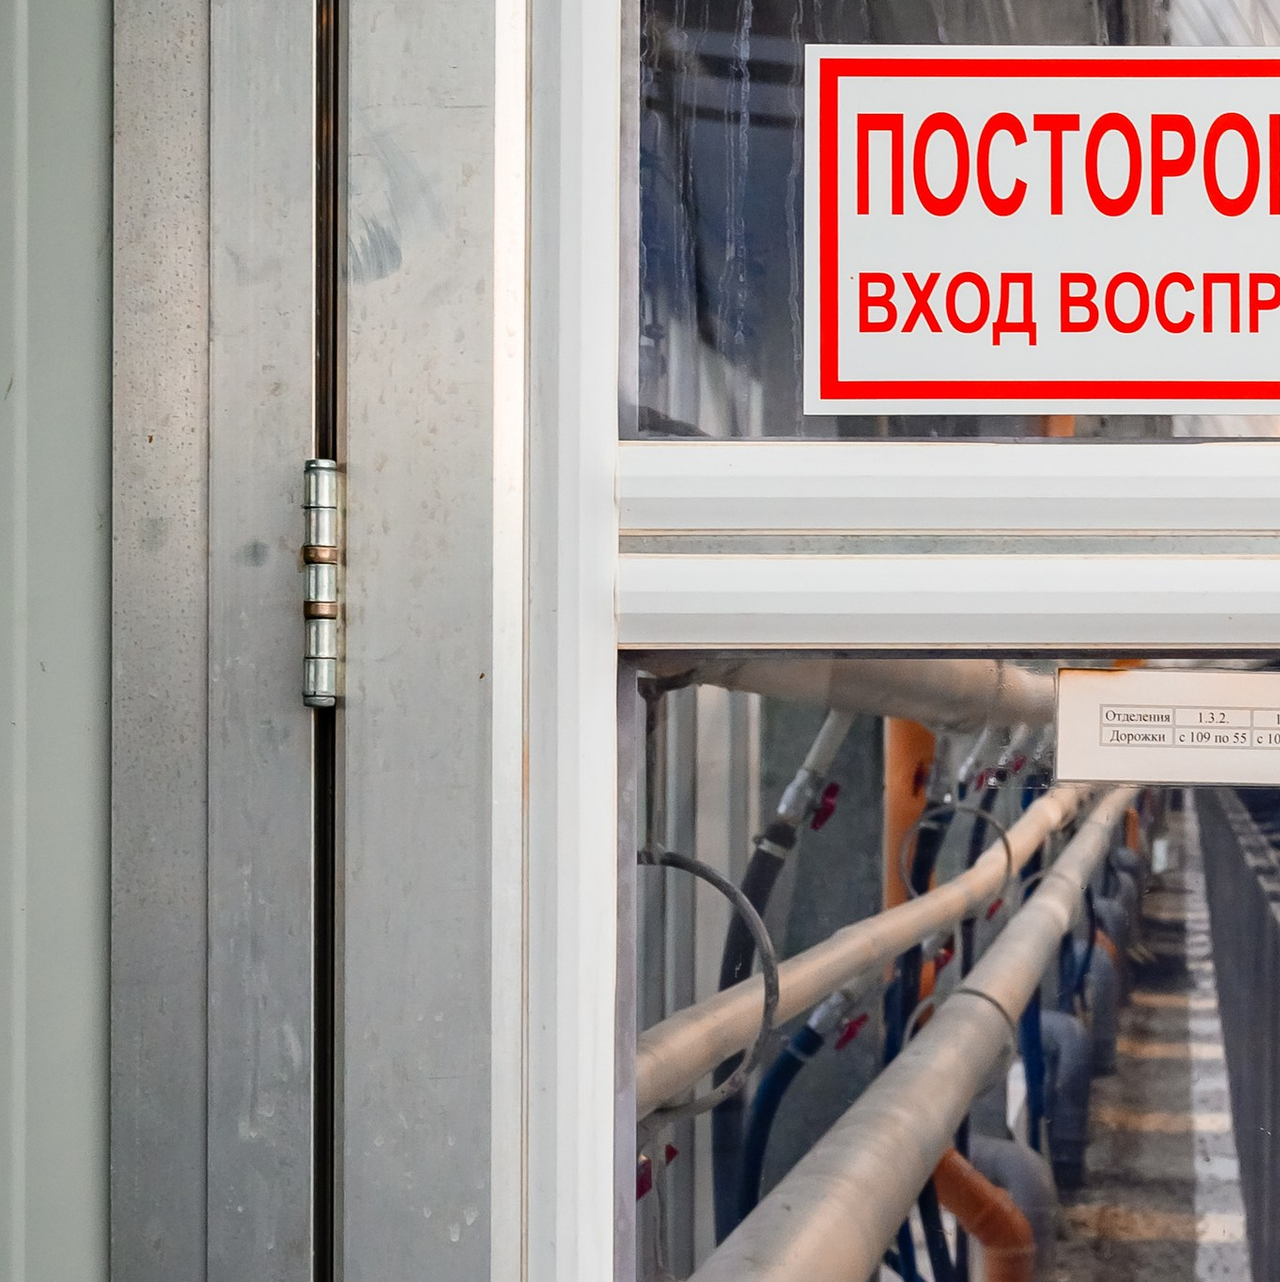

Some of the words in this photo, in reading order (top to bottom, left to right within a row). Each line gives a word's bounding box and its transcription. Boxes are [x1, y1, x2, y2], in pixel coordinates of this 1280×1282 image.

[858, 271, 1037, 346] ВХОД
[1105, 710, 1171, 723] Отделения
[1198, 712, 1230, 724] 1.3.2.
[1109, 730, 1166, 744] Дорожки
[1178, 733, 1186, 743] с
[1190, 731, 1211, 743] 109
[1214, 734, 1230, 744] по
[1232, 732, 1248, 744] 55
[1256, 734, 1264, 744] с
